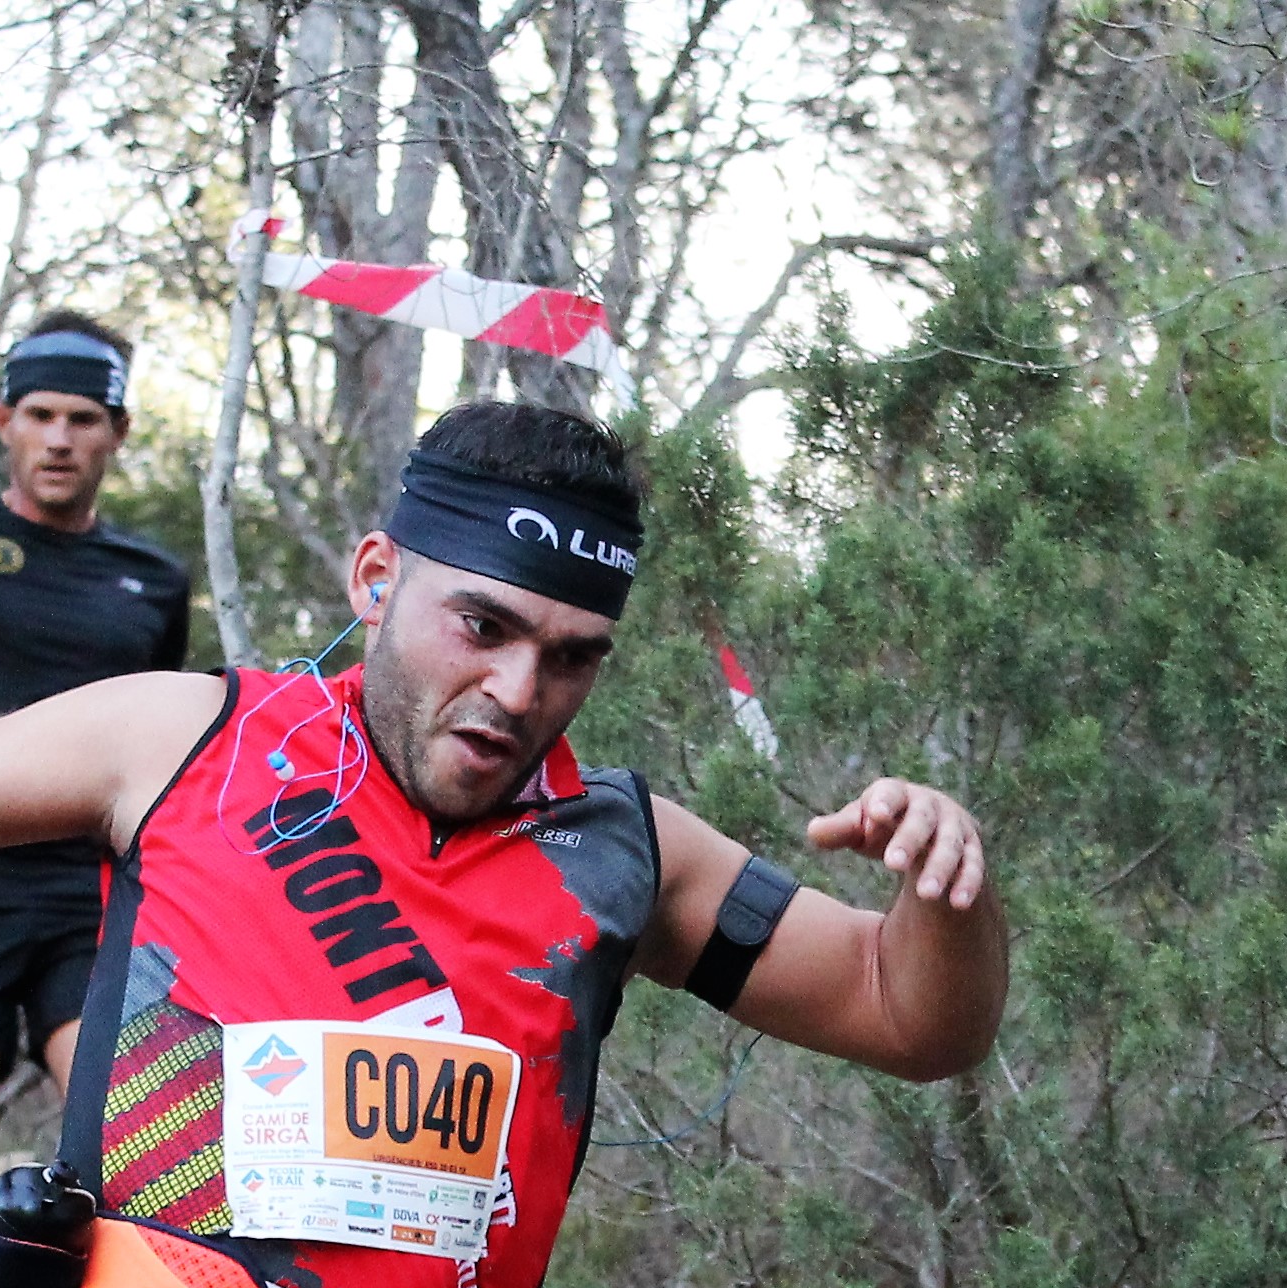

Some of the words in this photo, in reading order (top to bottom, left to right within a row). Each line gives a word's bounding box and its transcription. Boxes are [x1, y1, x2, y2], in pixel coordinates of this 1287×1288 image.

[244, 788, 447, 1004] MONT
[242, 1110, 286, 1126] CAMÍ
[291, 1112, 309, 1125] DE
[244, 1127, 310, 1145] SIRGA
[270, 1175, 304, 1186] TRAIL
[393, 1208, 421, 1222] BBVA
